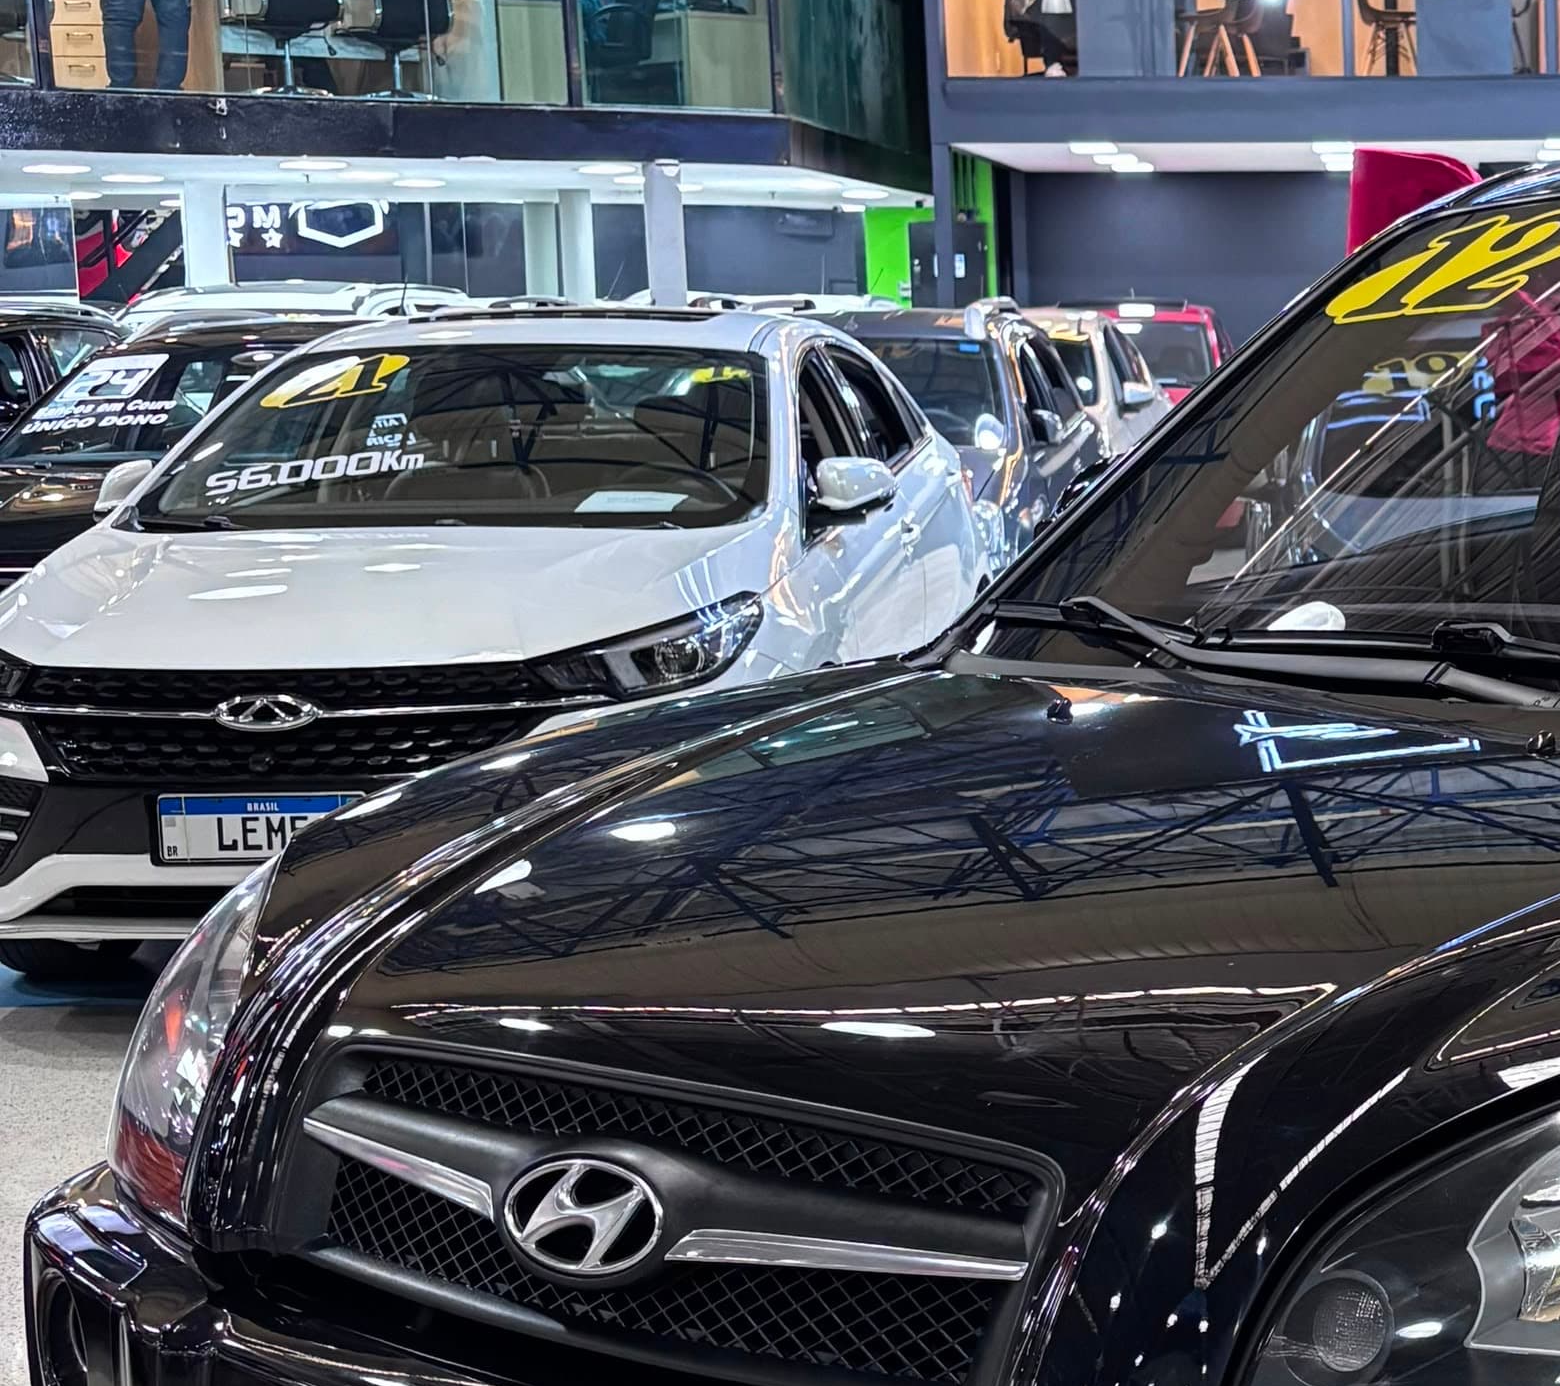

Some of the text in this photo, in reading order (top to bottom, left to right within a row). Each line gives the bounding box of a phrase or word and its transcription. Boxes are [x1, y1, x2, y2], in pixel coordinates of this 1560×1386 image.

[96, 401, 125, 413] em
[127, 399, 177, 411] Couro
[98, 413, 169, 427] DONO
[246, 802, 280, 813] BRASIL
[167, 845, 179, 857] BR
